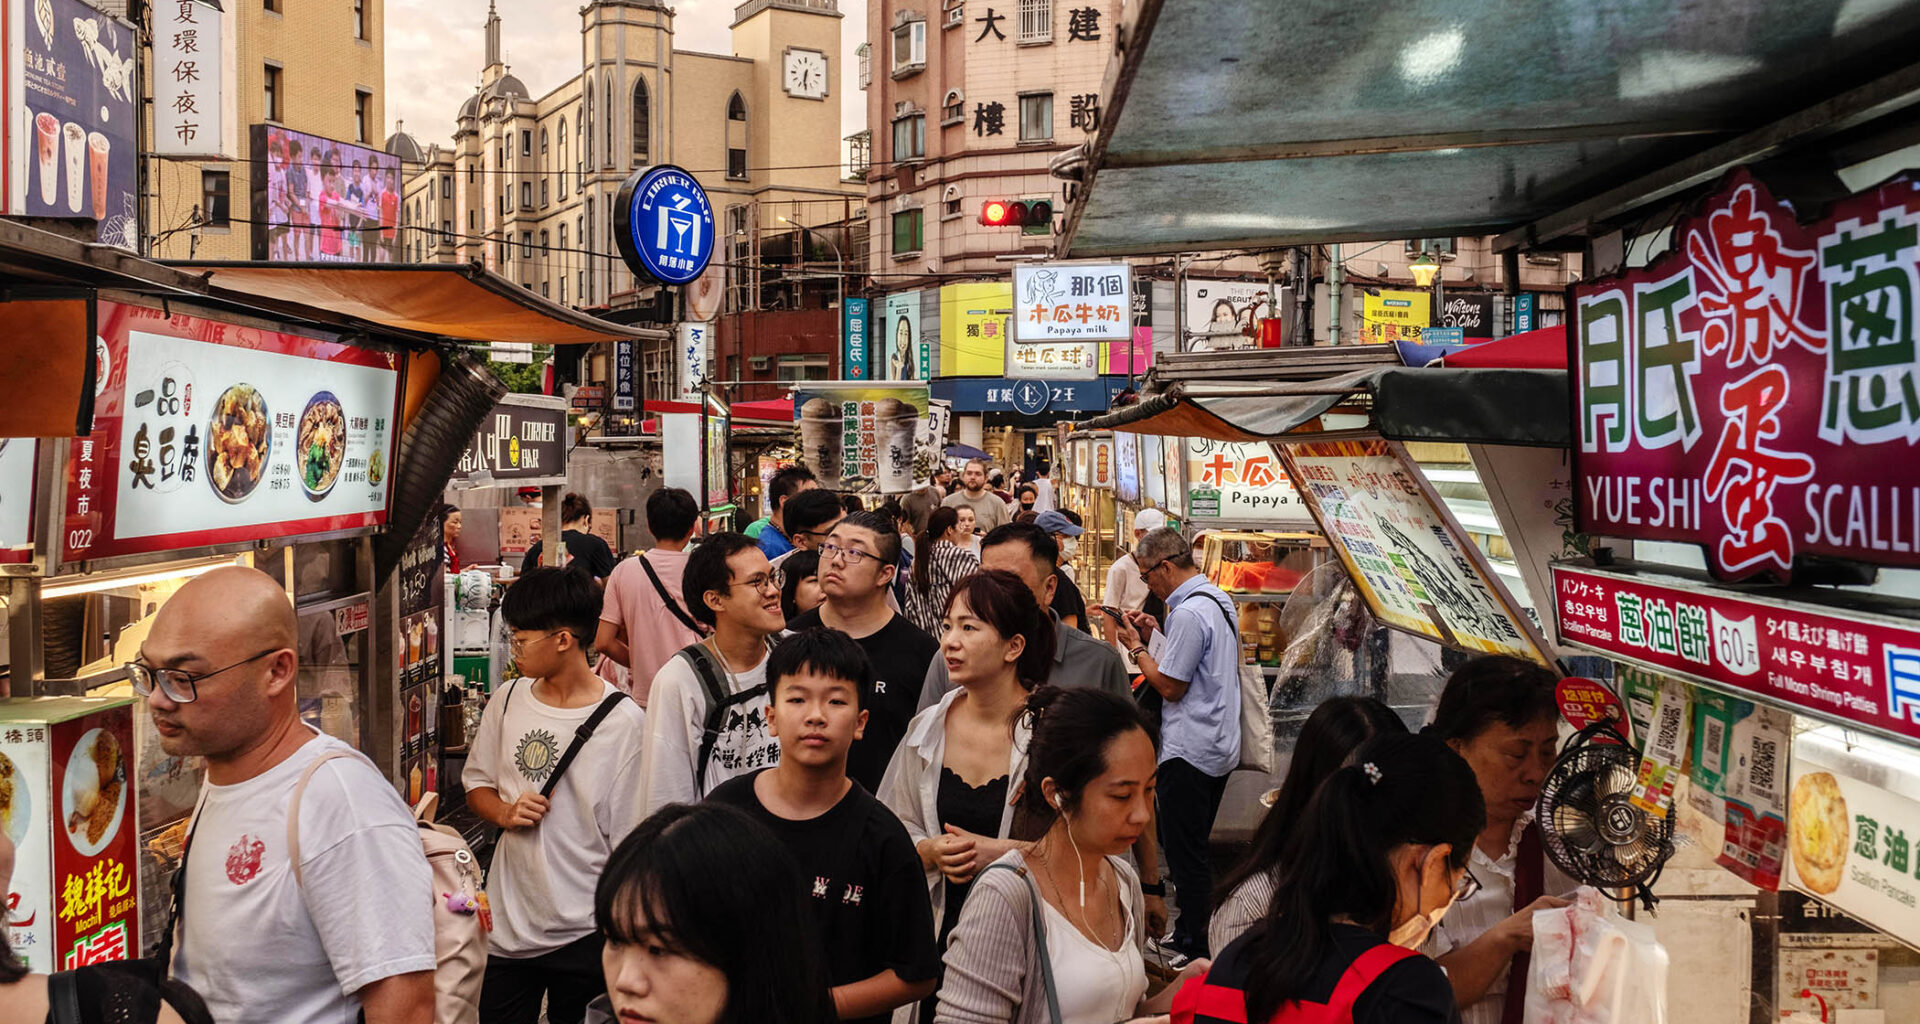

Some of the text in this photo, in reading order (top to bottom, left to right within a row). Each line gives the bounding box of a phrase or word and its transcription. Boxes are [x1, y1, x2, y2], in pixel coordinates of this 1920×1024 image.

[643, 176, 710, 224] CORNER BAR
[1071, 274, 1123, 297] 那個
[1029, 303, 1120, 324] 木瓜牛奶
[1444, 298, 1480, 315] Watsons
[967, 320, 1005, 338] 獨享
[1047, 325, 1108, 336] Papaya milk
[1457, 314, 1480, 328] Club
[1016, 346, 1082, 363] 地瓜球
[1577, 265, 1704, 455] 月氏
[619, 342, 631, 393] 數位影像
[986, 387, 1075, 402] 紅茶 之王
[275, 413, 296, 428] 臭豆腐
[522, 421, 555, 442] CORNER
[844, 402, 858, 477] 招牌綠豆沙
[861, 402, 875, 477] 綠豆沙牛奶
[129, 421, 200, 489] 臭豆腐
[522, 449, 539, 469] BAR
[76, 417, 95, 516] 夏夜市
[1232, 491, 1288, 508] Papaya
[1587, 476, 1701, 530] YUE SHI
[69, 529, 93, 549] 022
[1565, 600, 1607, 622] 총요우빙
[1563, 618, 1612, 642] Scallion Pancake
[1719, 625, 1757, 668] 60元
[875, 681, 886, 694] R
[1768, 672, 1879, 715] Full Moon Shrimp Patties
[59, 858, 131, 925] 魏祥記
[1851, 865, 1916, 909] Scallion Pancake
[75, 912, 98, 934] Mochi
